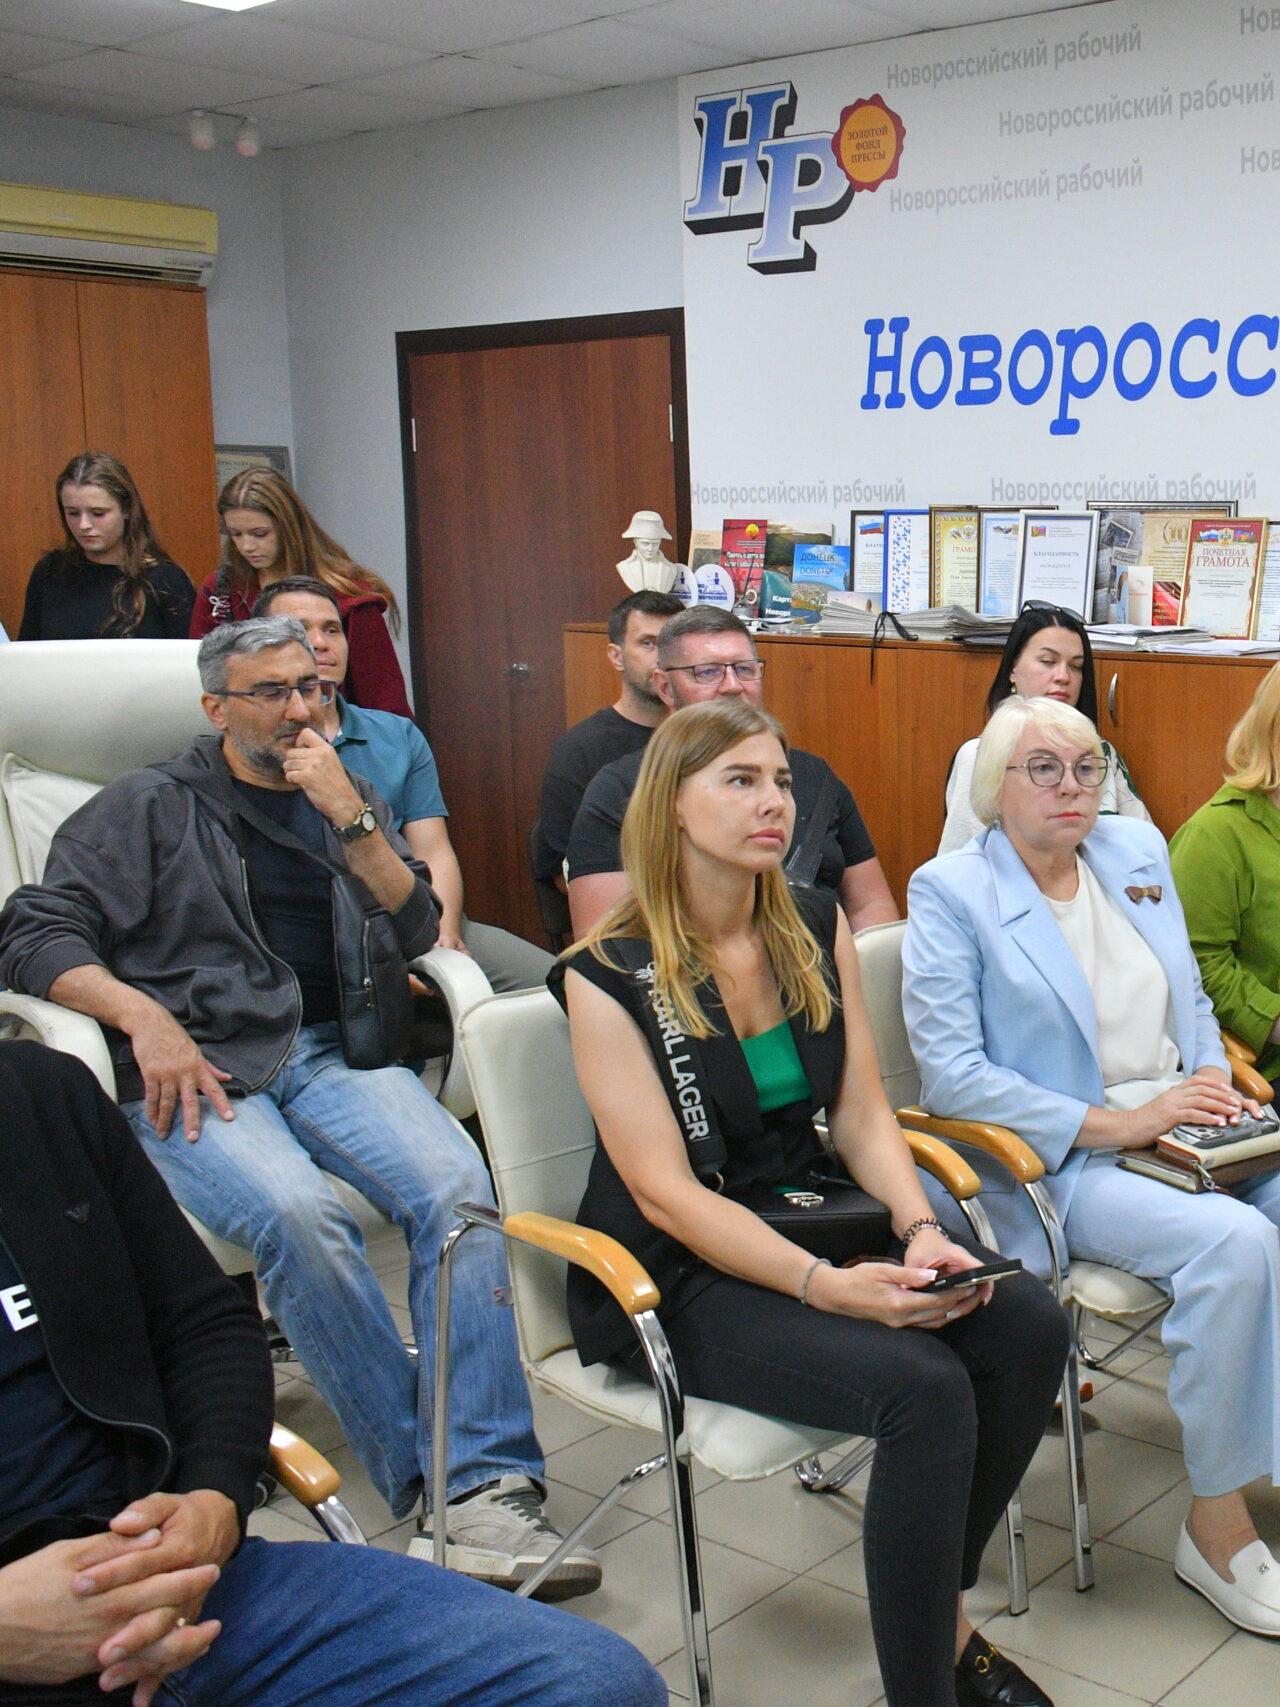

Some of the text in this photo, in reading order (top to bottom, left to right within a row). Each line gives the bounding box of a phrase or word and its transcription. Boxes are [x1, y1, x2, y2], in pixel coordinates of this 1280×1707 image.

[887, 25, 1142, 90] Новороссийский рабочий
[999, 72, 1275, 137] Новороссийский рабочий
[847, 126, 888, 141] ЗОЛОТОЙ
[855, 140, 881, 153] ФОНД
[850, 150, 887, 164] ПРЕССЫ
[888, 157, 1144, 213] Новороссийский рабочий
[833, 477, 905, 508] рабочий
[990, 472, 1257, 507] Новороссийский рабочий
[952, 545, 976, 553] ГРАМО
[801, 552, 835, 563] ДОНЕЦК
[1196, 556, 1250, 568] ГРАМОТА
[772, 595, 792, 604] Карт
[765, 608, 791, 617] Новор
[669, 1054, 710, 1141] LAGER
